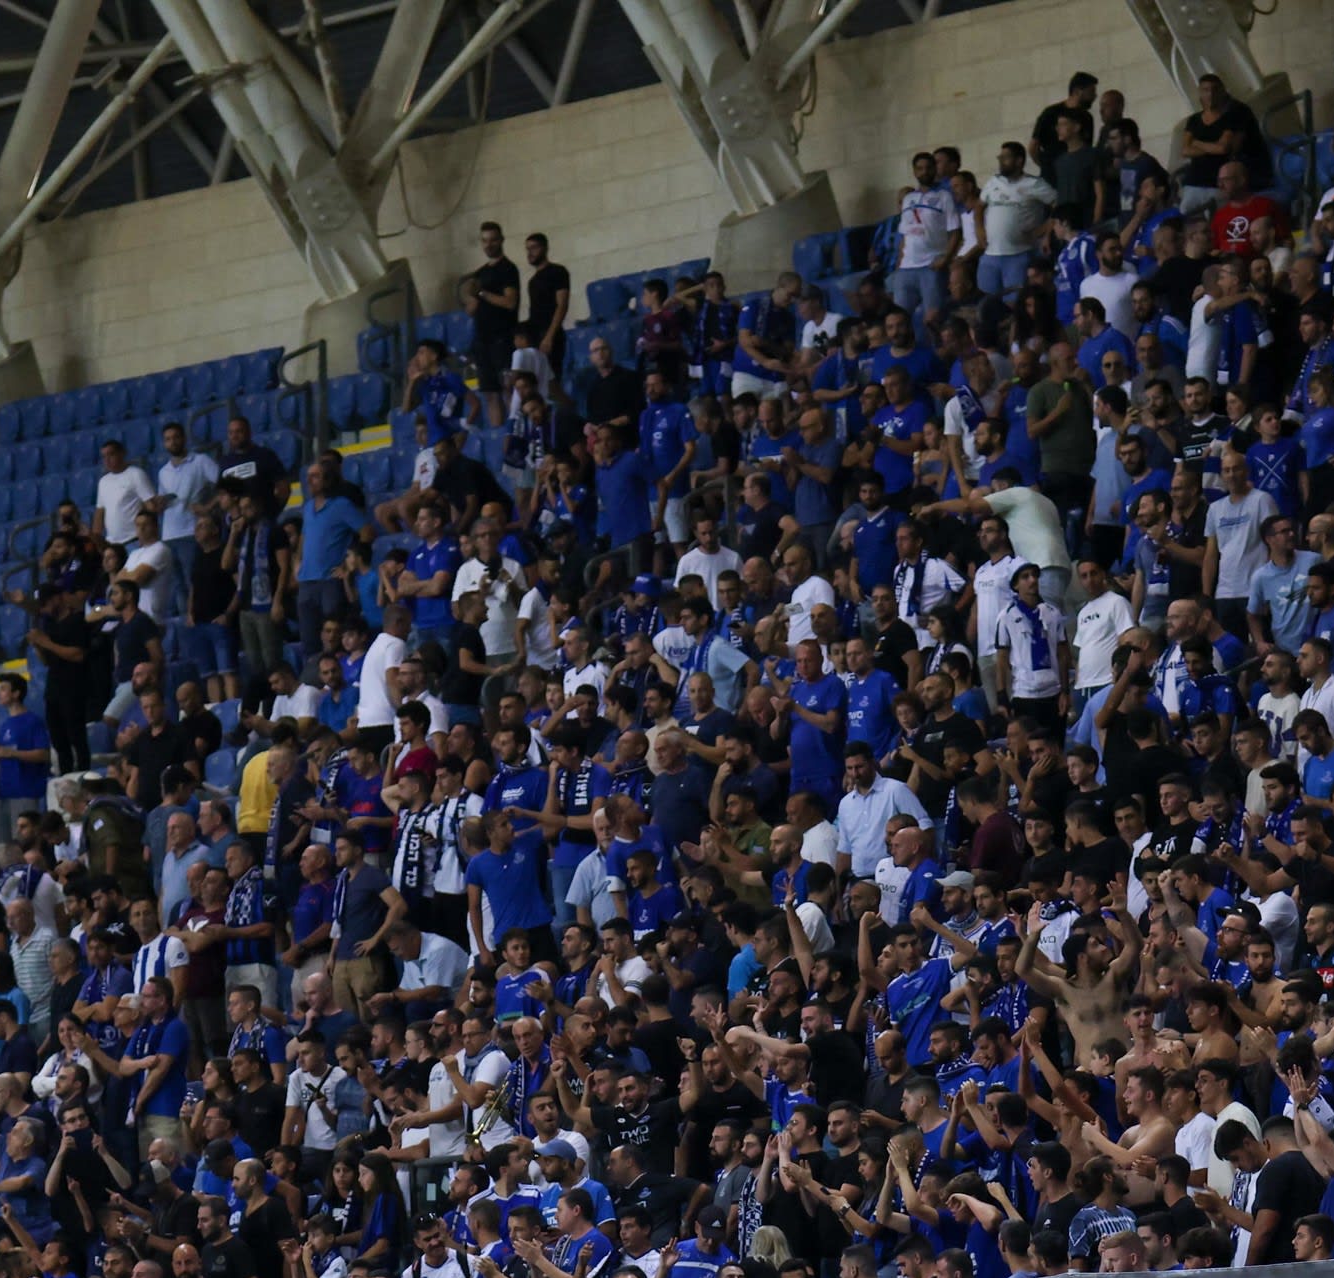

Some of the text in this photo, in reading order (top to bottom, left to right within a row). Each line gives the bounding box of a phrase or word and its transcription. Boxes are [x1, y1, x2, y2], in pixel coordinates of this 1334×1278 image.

[1039, 935, 1056, 944] WO
[620, 1125, 649, 1139] TWO
[629, 1136, 650, 1145] NIL
